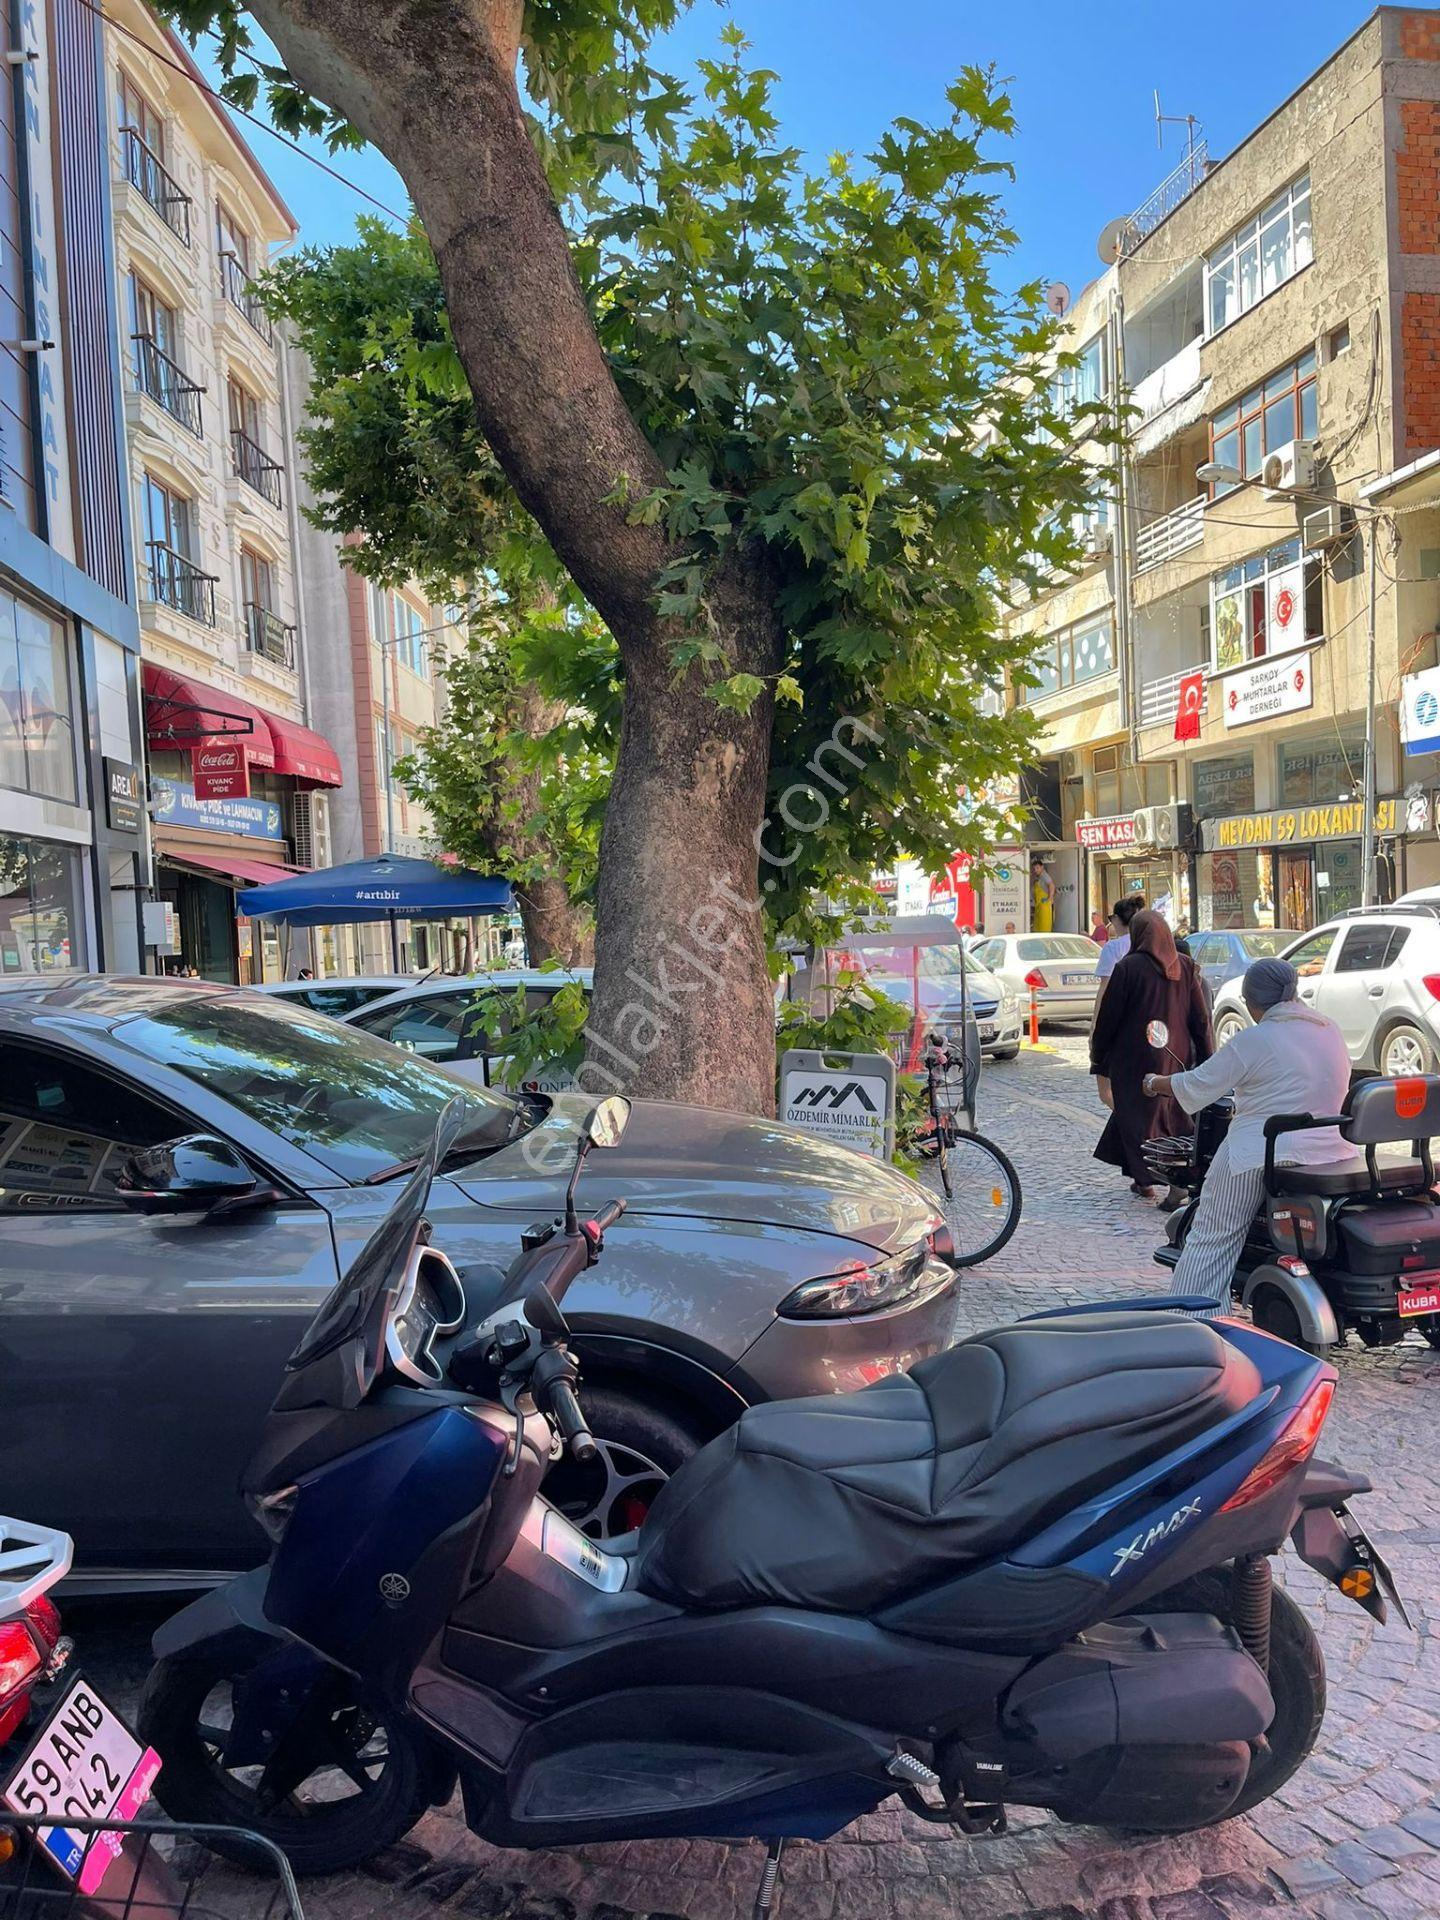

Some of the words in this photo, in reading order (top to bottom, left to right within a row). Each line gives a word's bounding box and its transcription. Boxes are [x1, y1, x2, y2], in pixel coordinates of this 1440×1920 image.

[1243, 681, 1288, 702] MUHTARLAR
[111, 773, 132, 797] AREA
[1219, 814, 1273, 846] MEYDAN
[1277, 816, 1297, 840] 59
[1300, 799, 1397, 839] LOKANTSI
[1081, 826, 1105, 848] ŞEN
[787, 1107, 829, 1125] ÖZDEMİR
[1402, 1295, 1438, 1310] KUBA
[1110, 1496, 1202, 1577] XMAX
[14, 1758, 62, 1817] 59
[50, 1692, 104, 1772] ANB
[64, 1753, 121, 1835] 042
[66, 1848, 83, 1868] TR
